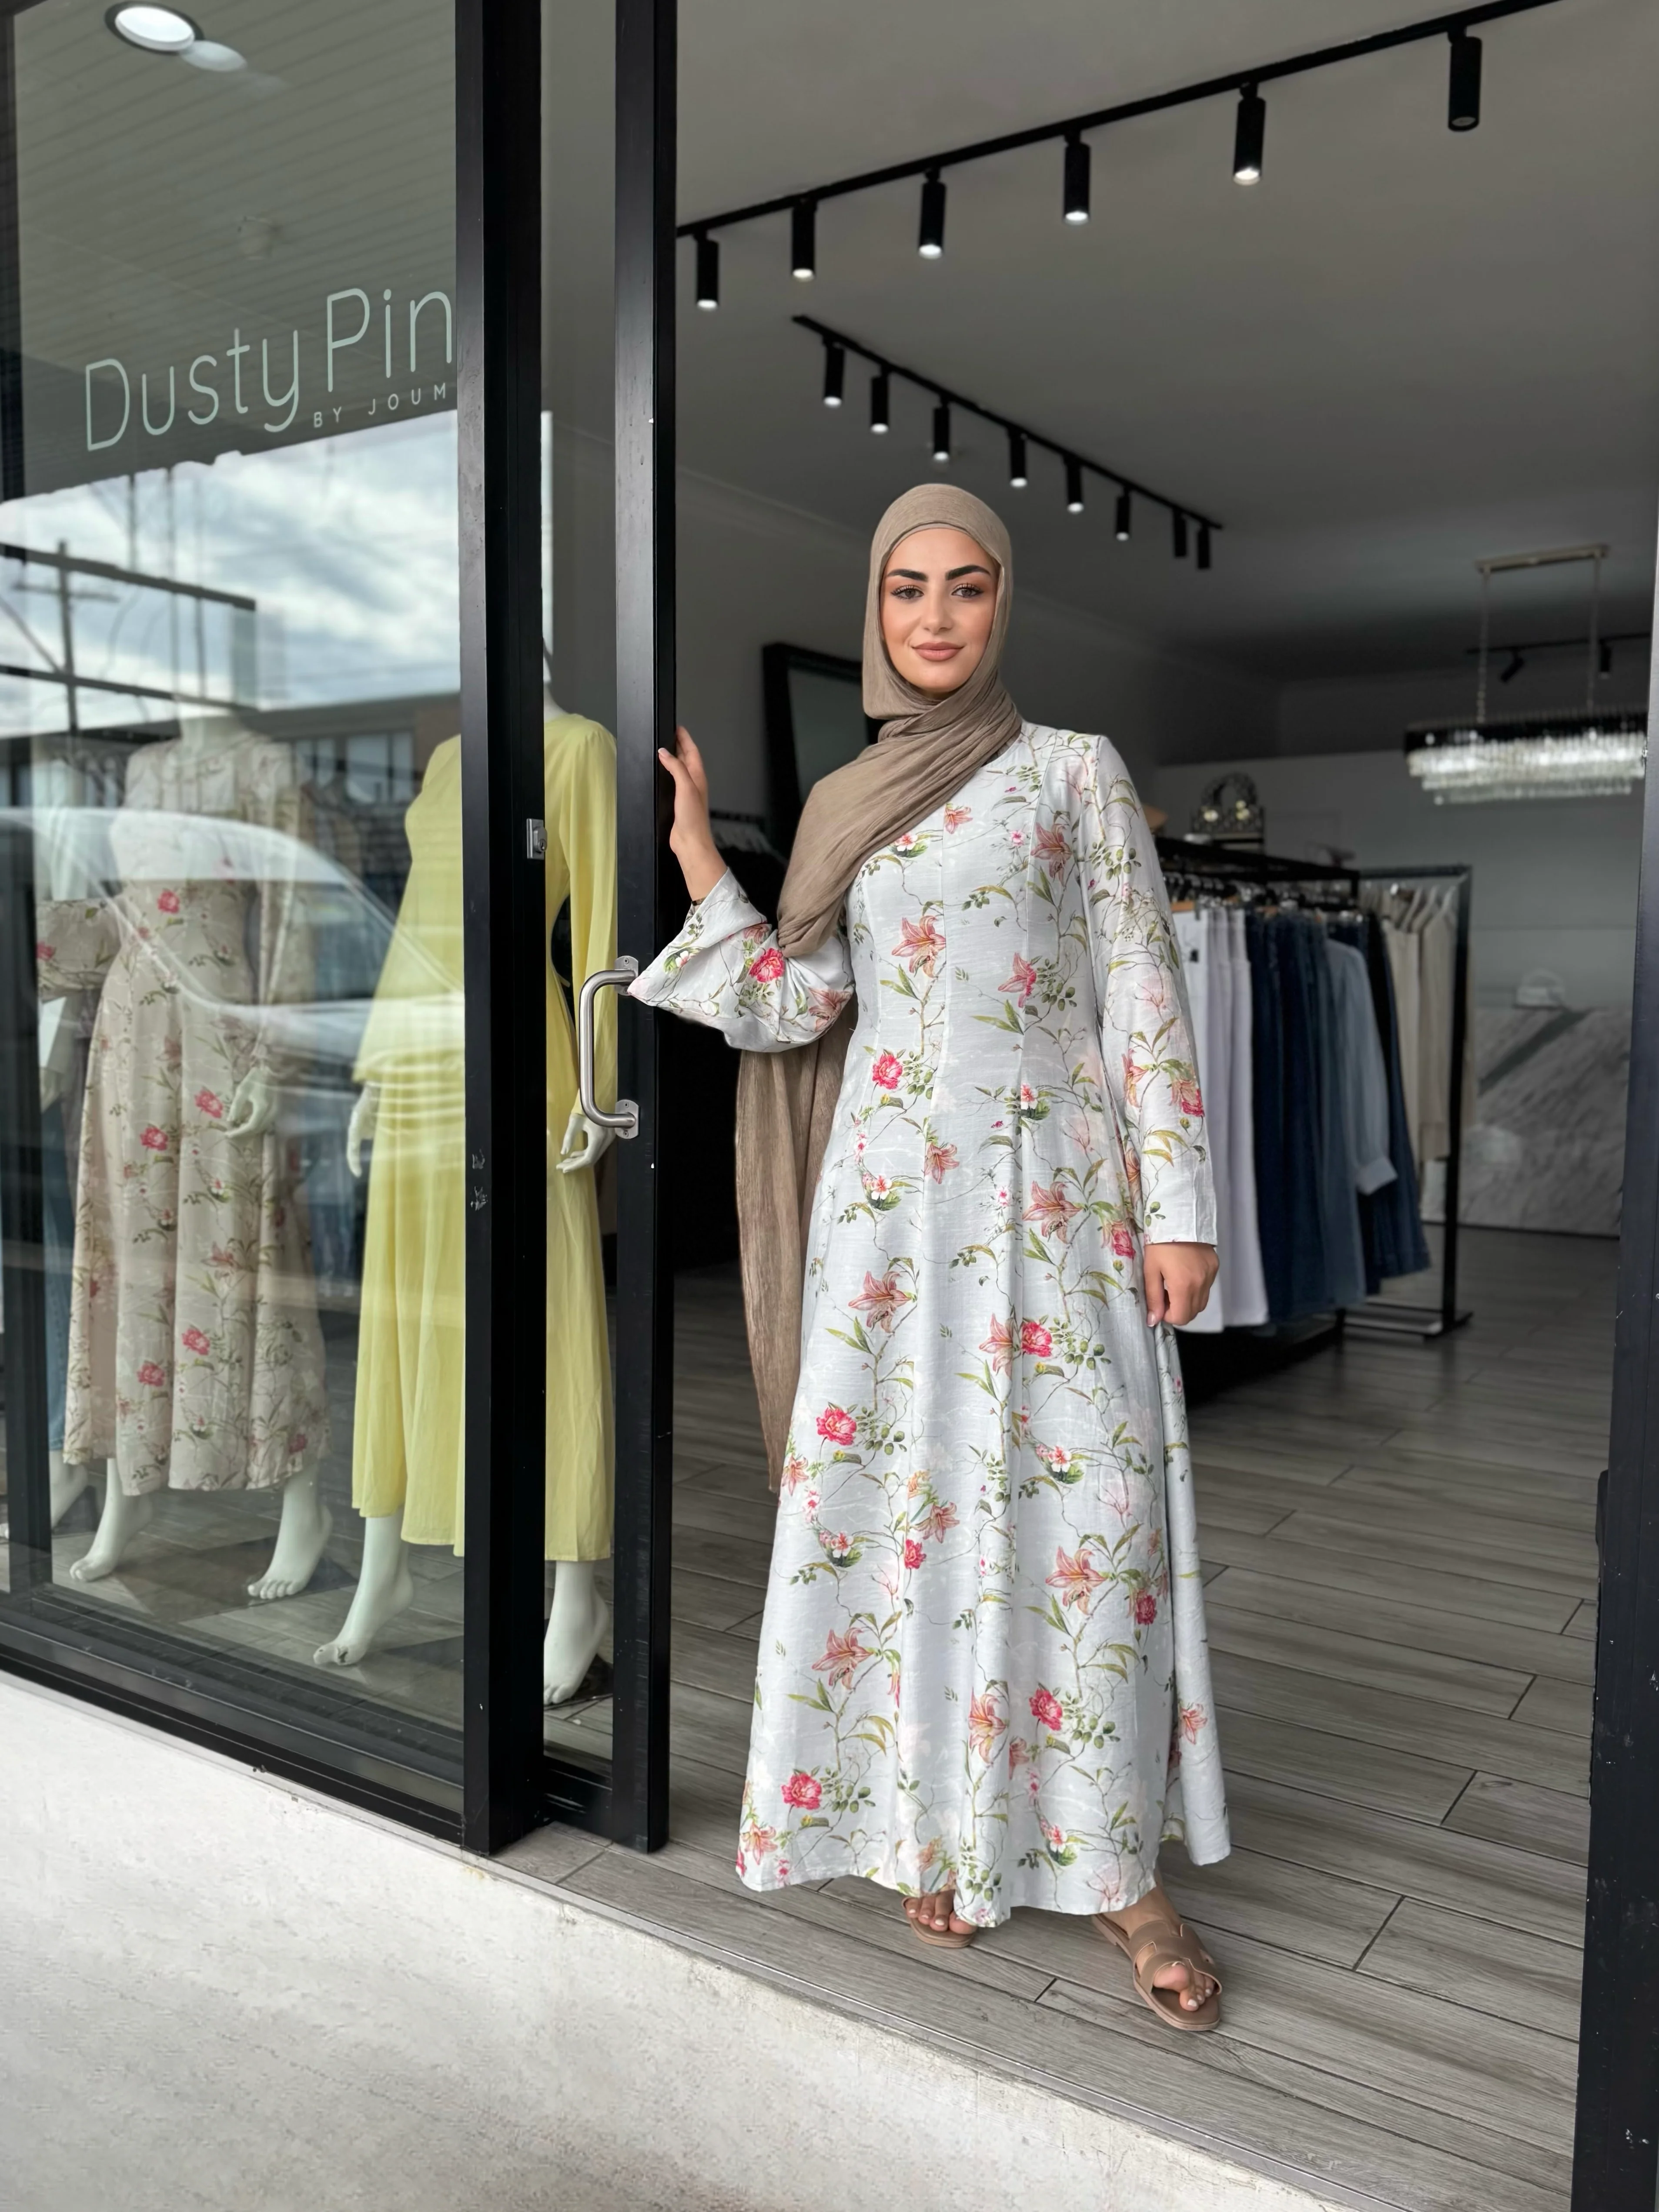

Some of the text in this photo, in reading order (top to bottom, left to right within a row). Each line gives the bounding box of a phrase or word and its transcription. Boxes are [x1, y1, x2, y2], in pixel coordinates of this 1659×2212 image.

[86, 288, 452, 451] Dusty Pin
[314, 382, 446, 428] BY JOUM
